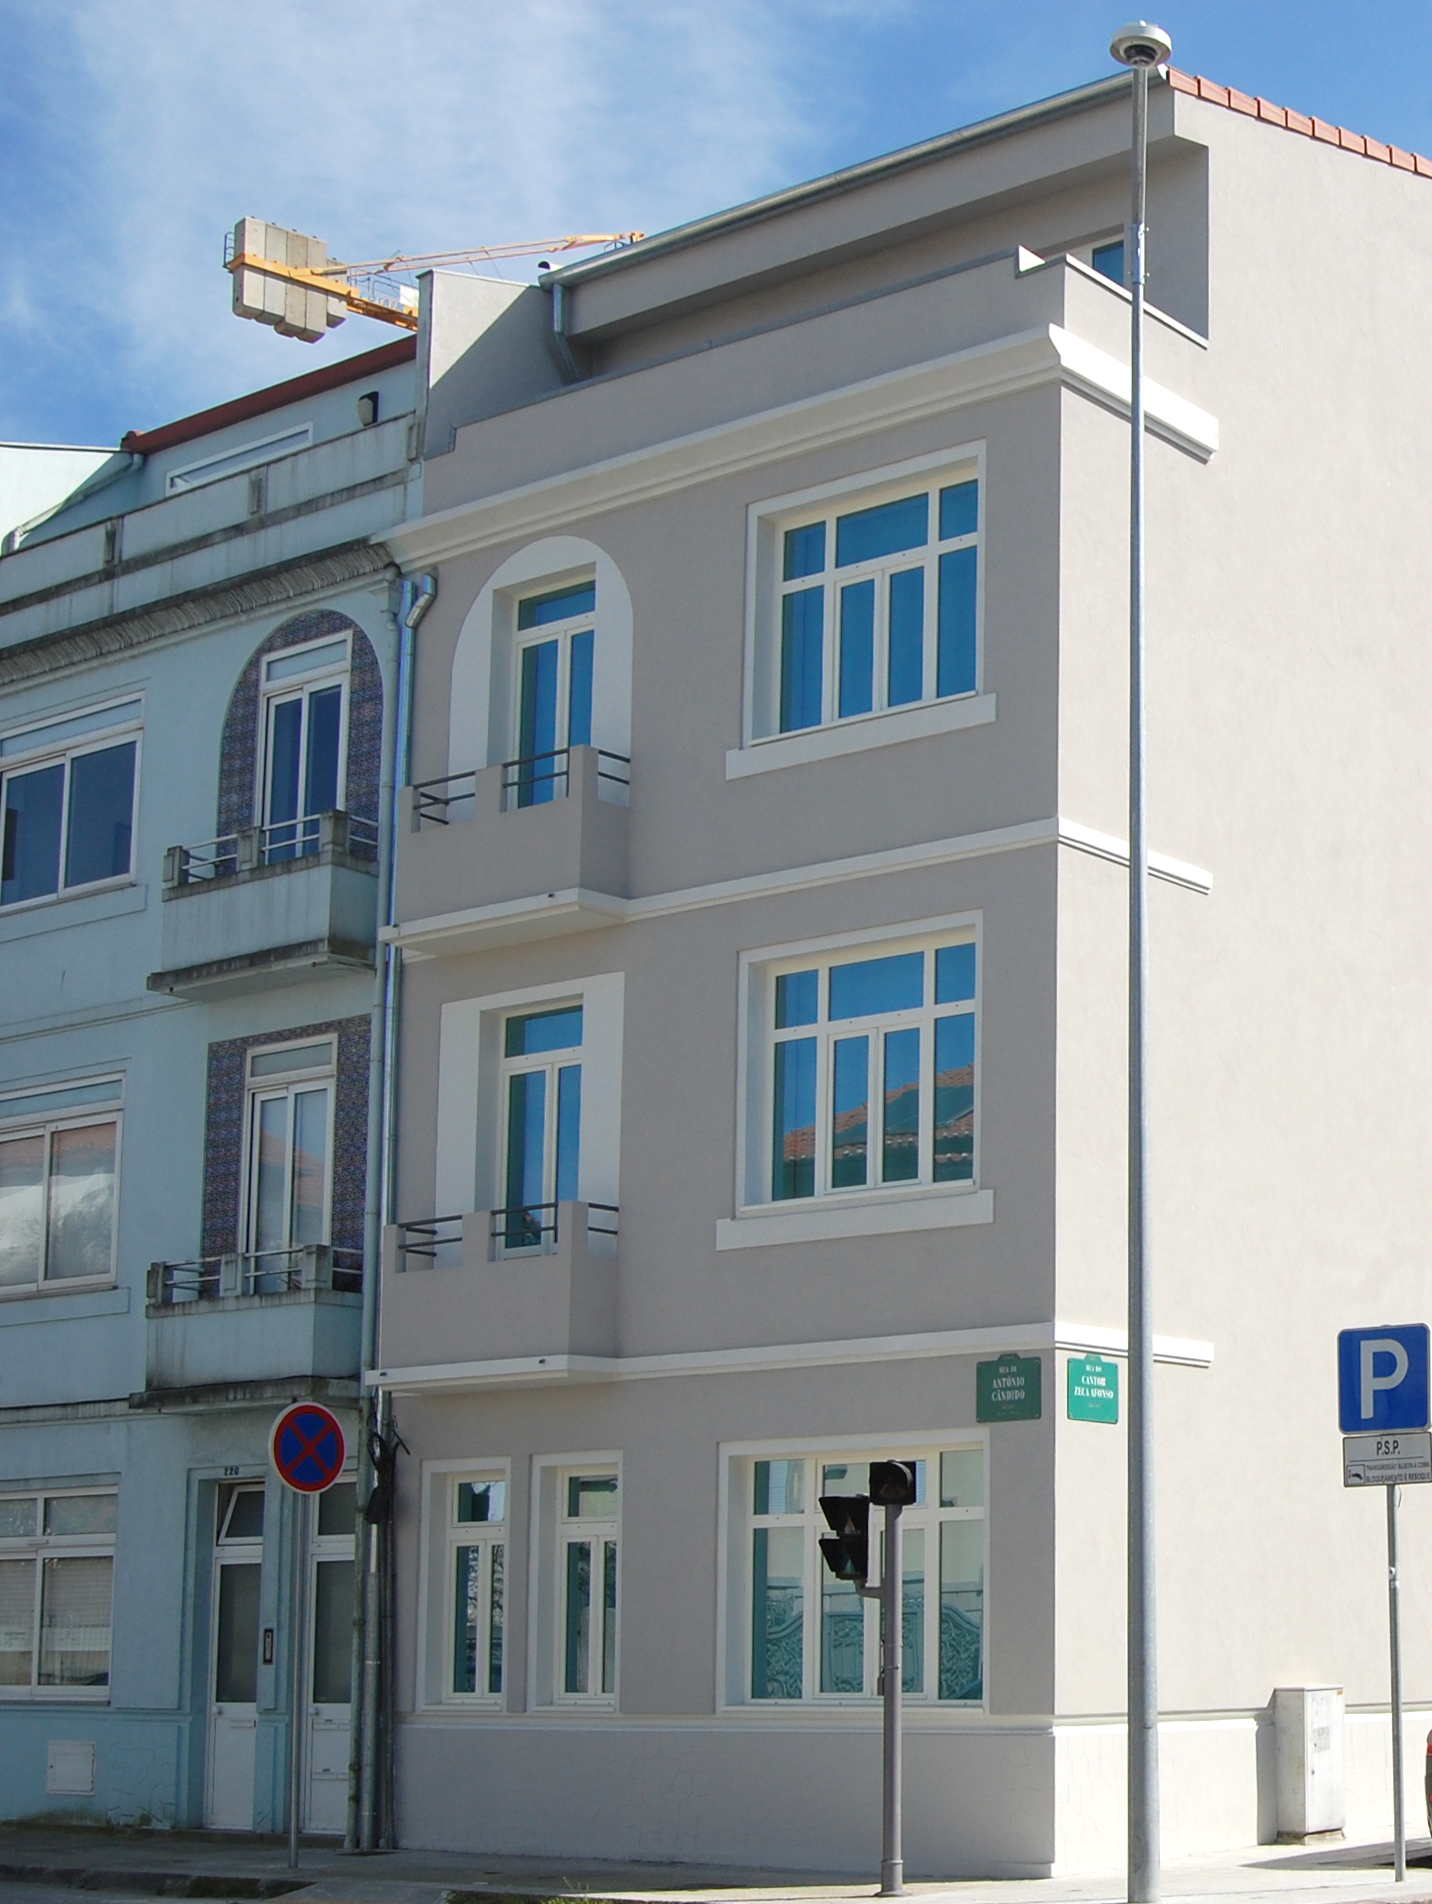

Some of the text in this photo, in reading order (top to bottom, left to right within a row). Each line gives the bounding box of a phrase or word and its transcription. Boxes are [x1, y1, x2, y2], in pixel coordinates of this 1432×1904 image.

[992, 1375, 1025, 1388] ANTÓNIO
[1081, 1375, 1106, 1386] CANTOR
[1361, 1339, 1409, 1419] P
[991, 1389, 1025, 1401] CÂNDIDO
[1074, 1386, 1114, 1399] ZECA AFONSO
[1376, 1440, 1401, 1456] P.S.P.
[224, 1466, 240, 1476] 220
